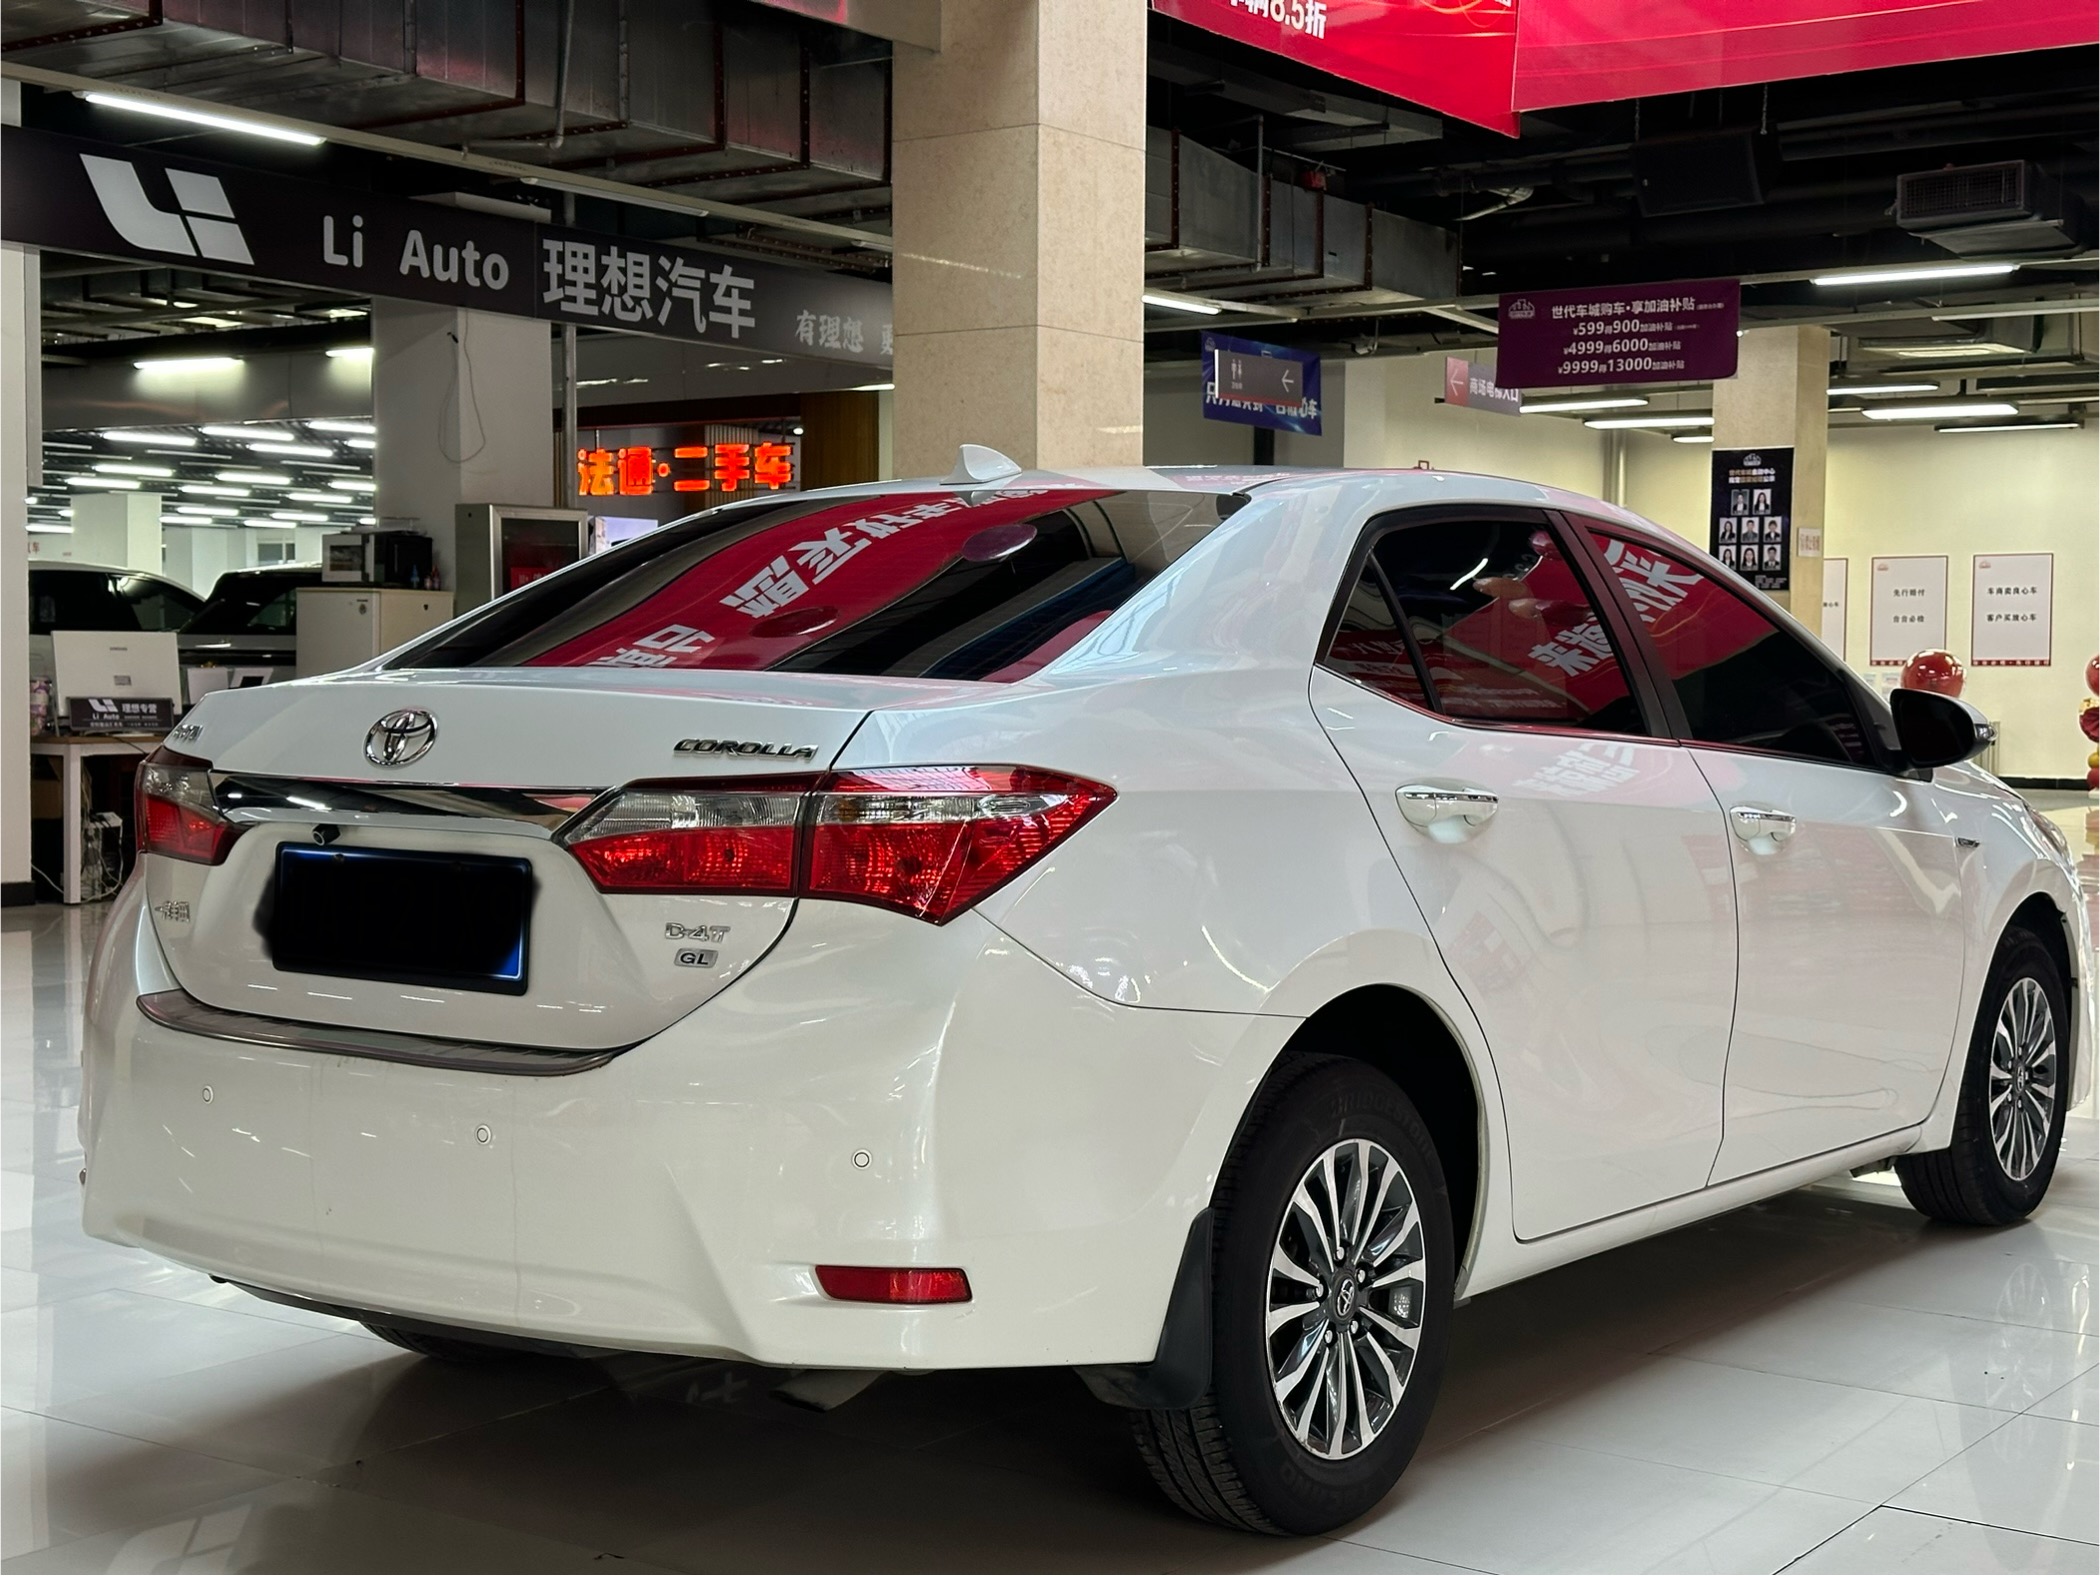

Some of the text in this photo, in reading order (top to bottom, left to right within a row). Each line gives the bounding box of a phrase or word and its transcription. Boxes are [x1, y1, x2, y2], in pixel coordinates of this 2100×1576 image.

[323, 215, 509, 290] Li Auto
[543, 237, 756, 339] 理想汽车
[795, 309, 863, 353] 有理想
[673, 738, 818, 762] COROLLA
[665, 922, 731, 943] D-4T
[680, 952, 709, 966] GL
